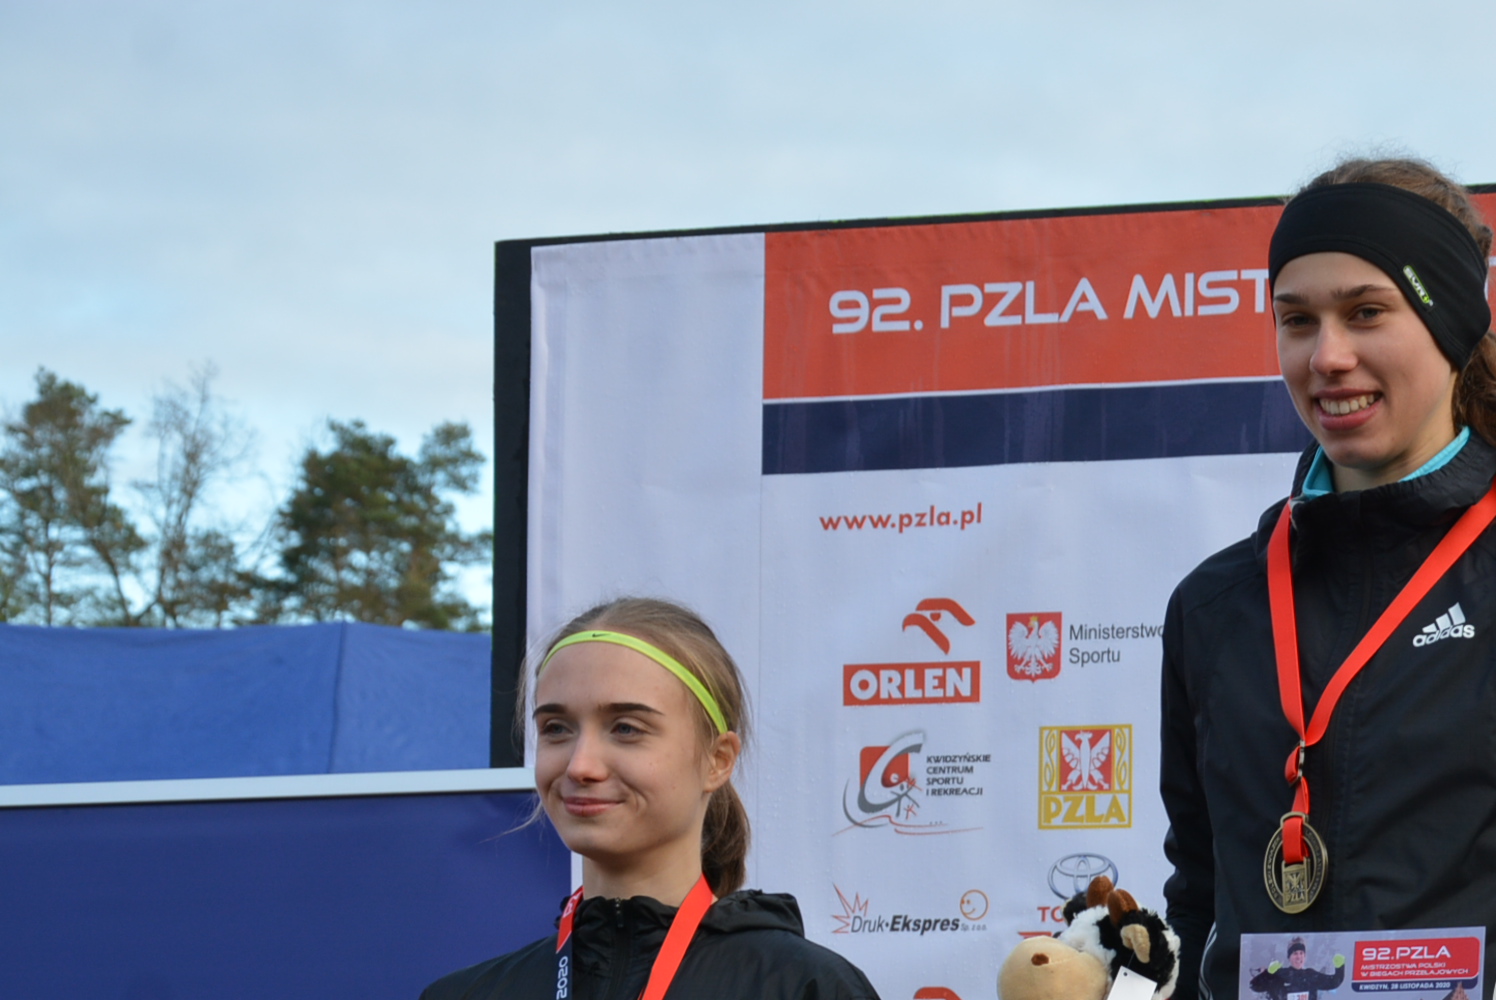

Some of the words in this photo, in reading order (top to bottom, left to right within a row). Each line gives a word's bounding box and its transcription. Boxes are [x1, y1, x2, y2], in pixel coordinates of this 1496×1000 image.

[828, 286, 924, 334] 92.
[940, 276, 1109, 328] PZLA
[818, 502, 984, 534] www.pzla.pl
[1412, 624, 1476, 647] adidas
[1069, 647, 1121, 668] Sportu
[850, 666, 972, 700] ORLEN
[926, 765, 975, 775] CENTRUM
[926, 776, 964, 786] SPORTU
[931, 787, 983, 797] REKREACJI
[1043, 795, 1127, 825] PZLA
[1362, 945, 1452, 961] 92.PZLA
[555, 955, 569, 1000] 2020
